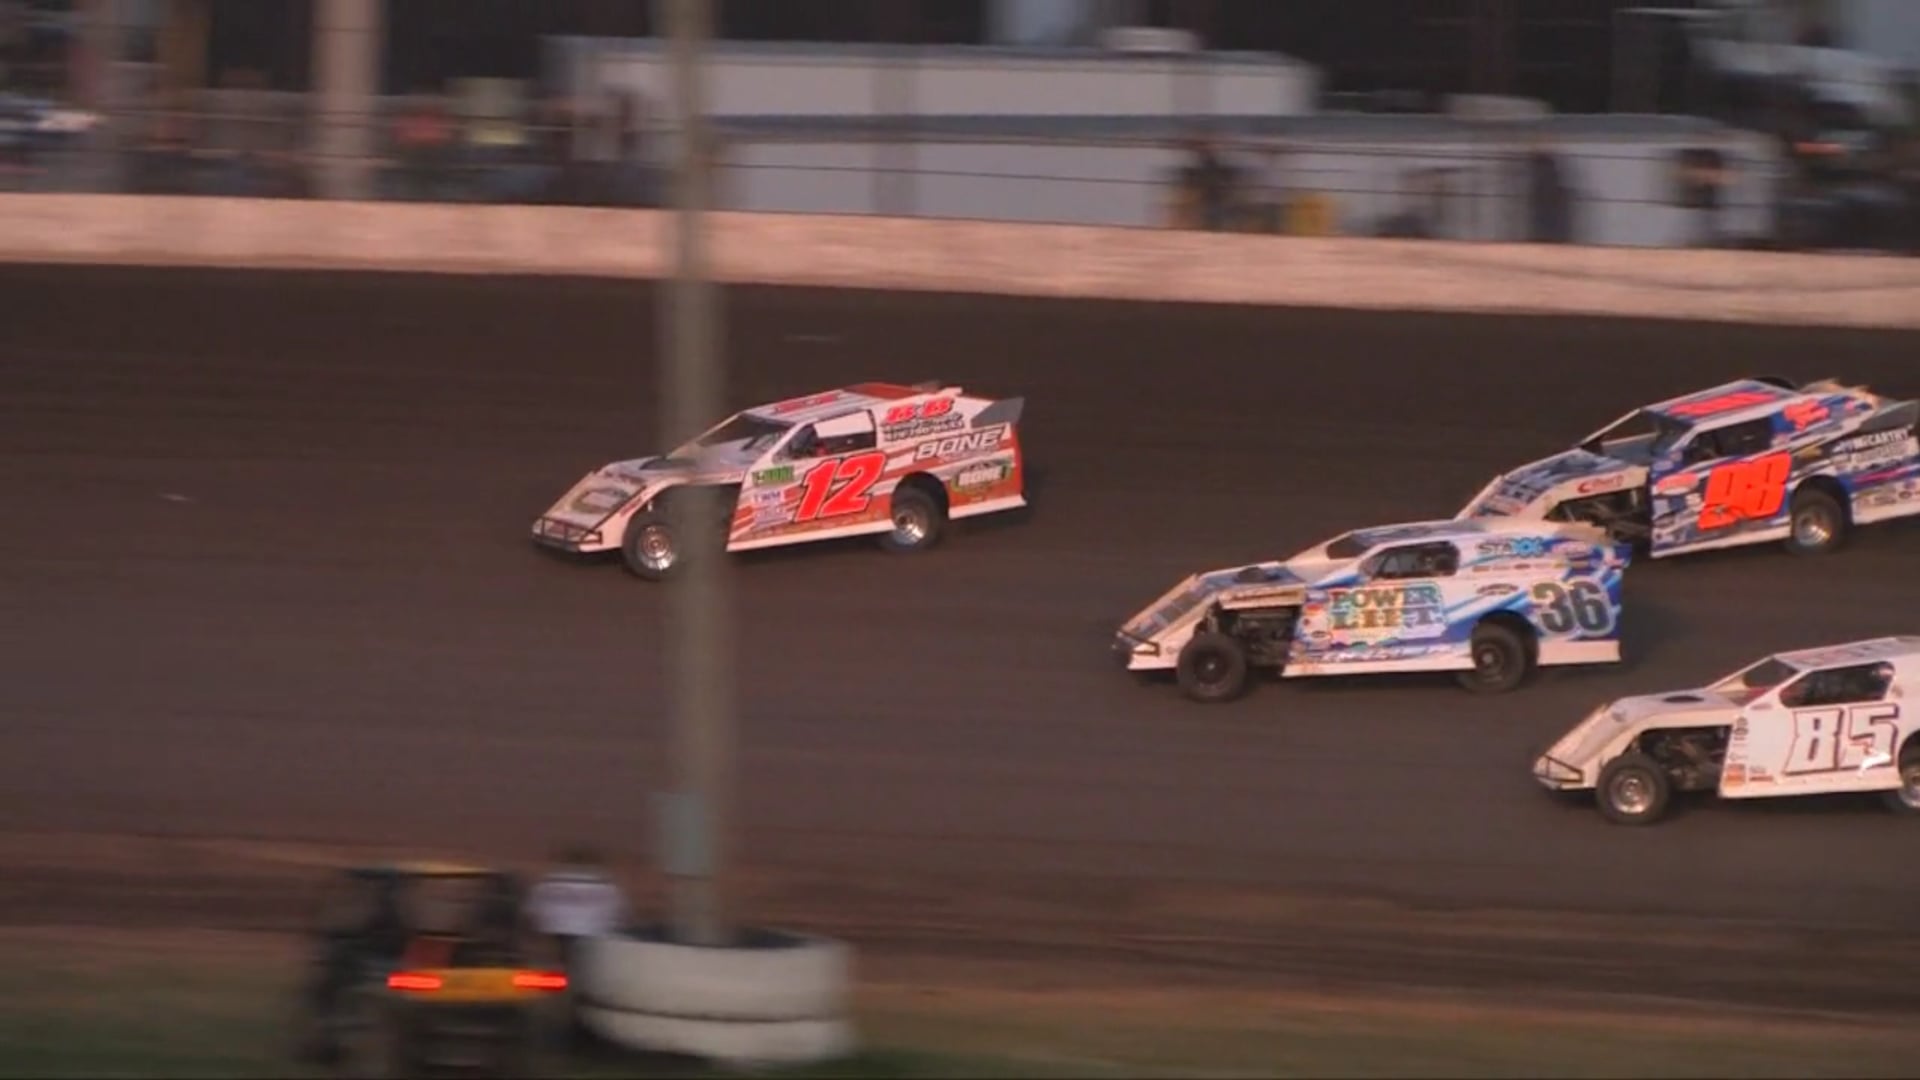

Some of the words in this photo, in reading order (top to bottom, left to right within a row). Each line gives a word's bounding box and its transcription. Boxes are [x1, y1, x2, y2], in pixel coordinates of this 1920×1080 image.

[914, 427, 1004, 462] BONE
[793, 452, 886, 523] 12
[1697, 449, 1792, 530] 98
[1330, 582, 1438, 613] POWER
[1532, 577, 1614, 635] 36
[1784, 701, 1899, 776] 85
